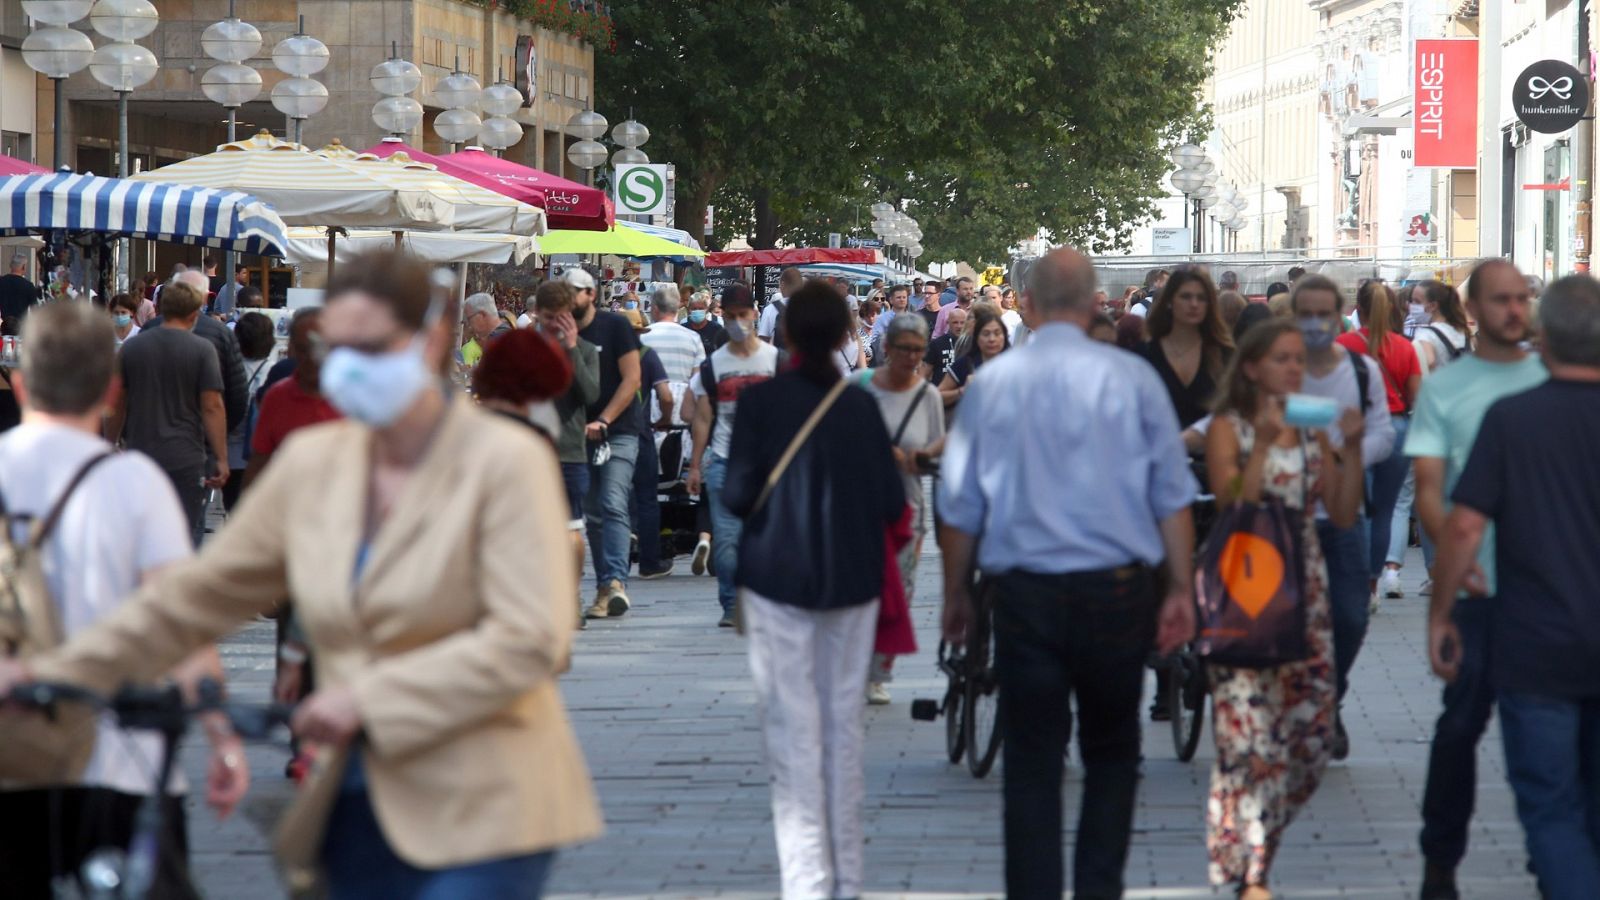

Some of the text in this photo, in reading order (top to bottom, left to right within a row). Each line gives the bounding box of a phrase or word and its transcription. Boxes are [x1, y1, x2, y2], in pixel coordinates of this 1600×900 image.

[1421, 53, 1443, 140] ESPRIT
[1521, 104, 1580, 115] hunkemöller
[626, 170, 656, 209] S
